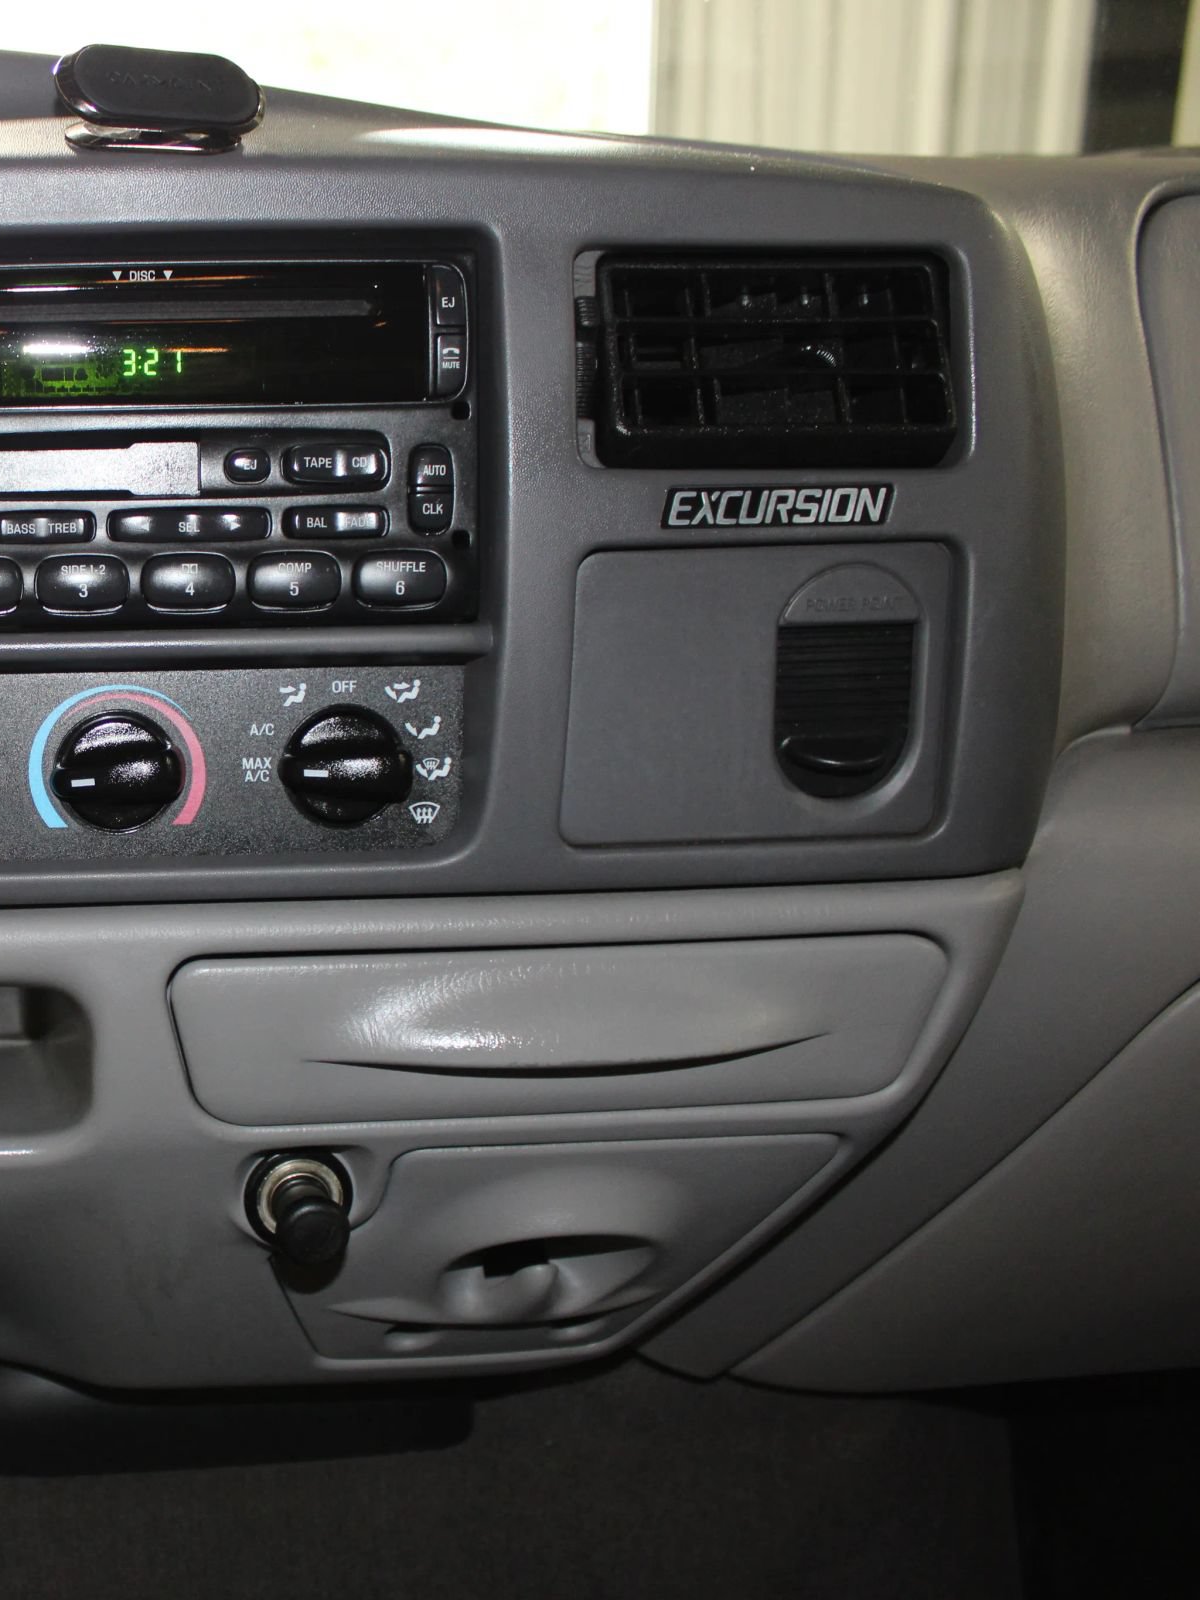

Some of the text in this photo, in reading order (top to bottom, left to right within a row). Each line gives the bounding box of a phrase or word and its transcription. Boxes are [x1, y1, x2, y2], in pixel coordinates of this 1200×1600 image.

[129, 269, 156, 282] DISC
[442, 297, 455, 308] EJ
[122, 347, 184, 378] 3:21
[442, 361, 460, 369] MUTE
[243, 459, 258, 471] EJ
[303, 456, 368, 469] TAPE CD
[422, 464, 447, 477] AUTO
[422, 503, 444, 515] CLK
[667, 487, 887, 526] EXCURSION
[7, 522, 78, 535] BASS TREB
[178, 521, 200, 533] SEL
[306, 516, 328, 529] BAL
[278, 562, 312, 574] COMP
[376, 561, 427, 573] SHUFFLE
[78, 584, 89, 598] 3
[185, 582, 195, 597] 4
[289, 581, 299, 596] 5
[395, 580, 405, 596] 6
[332, 680, 357, 693] OFF
[250, 723, 275, 736] A/C
[242, 758, 272, 770] MAX
[245, 769, 270, 782] A/C
